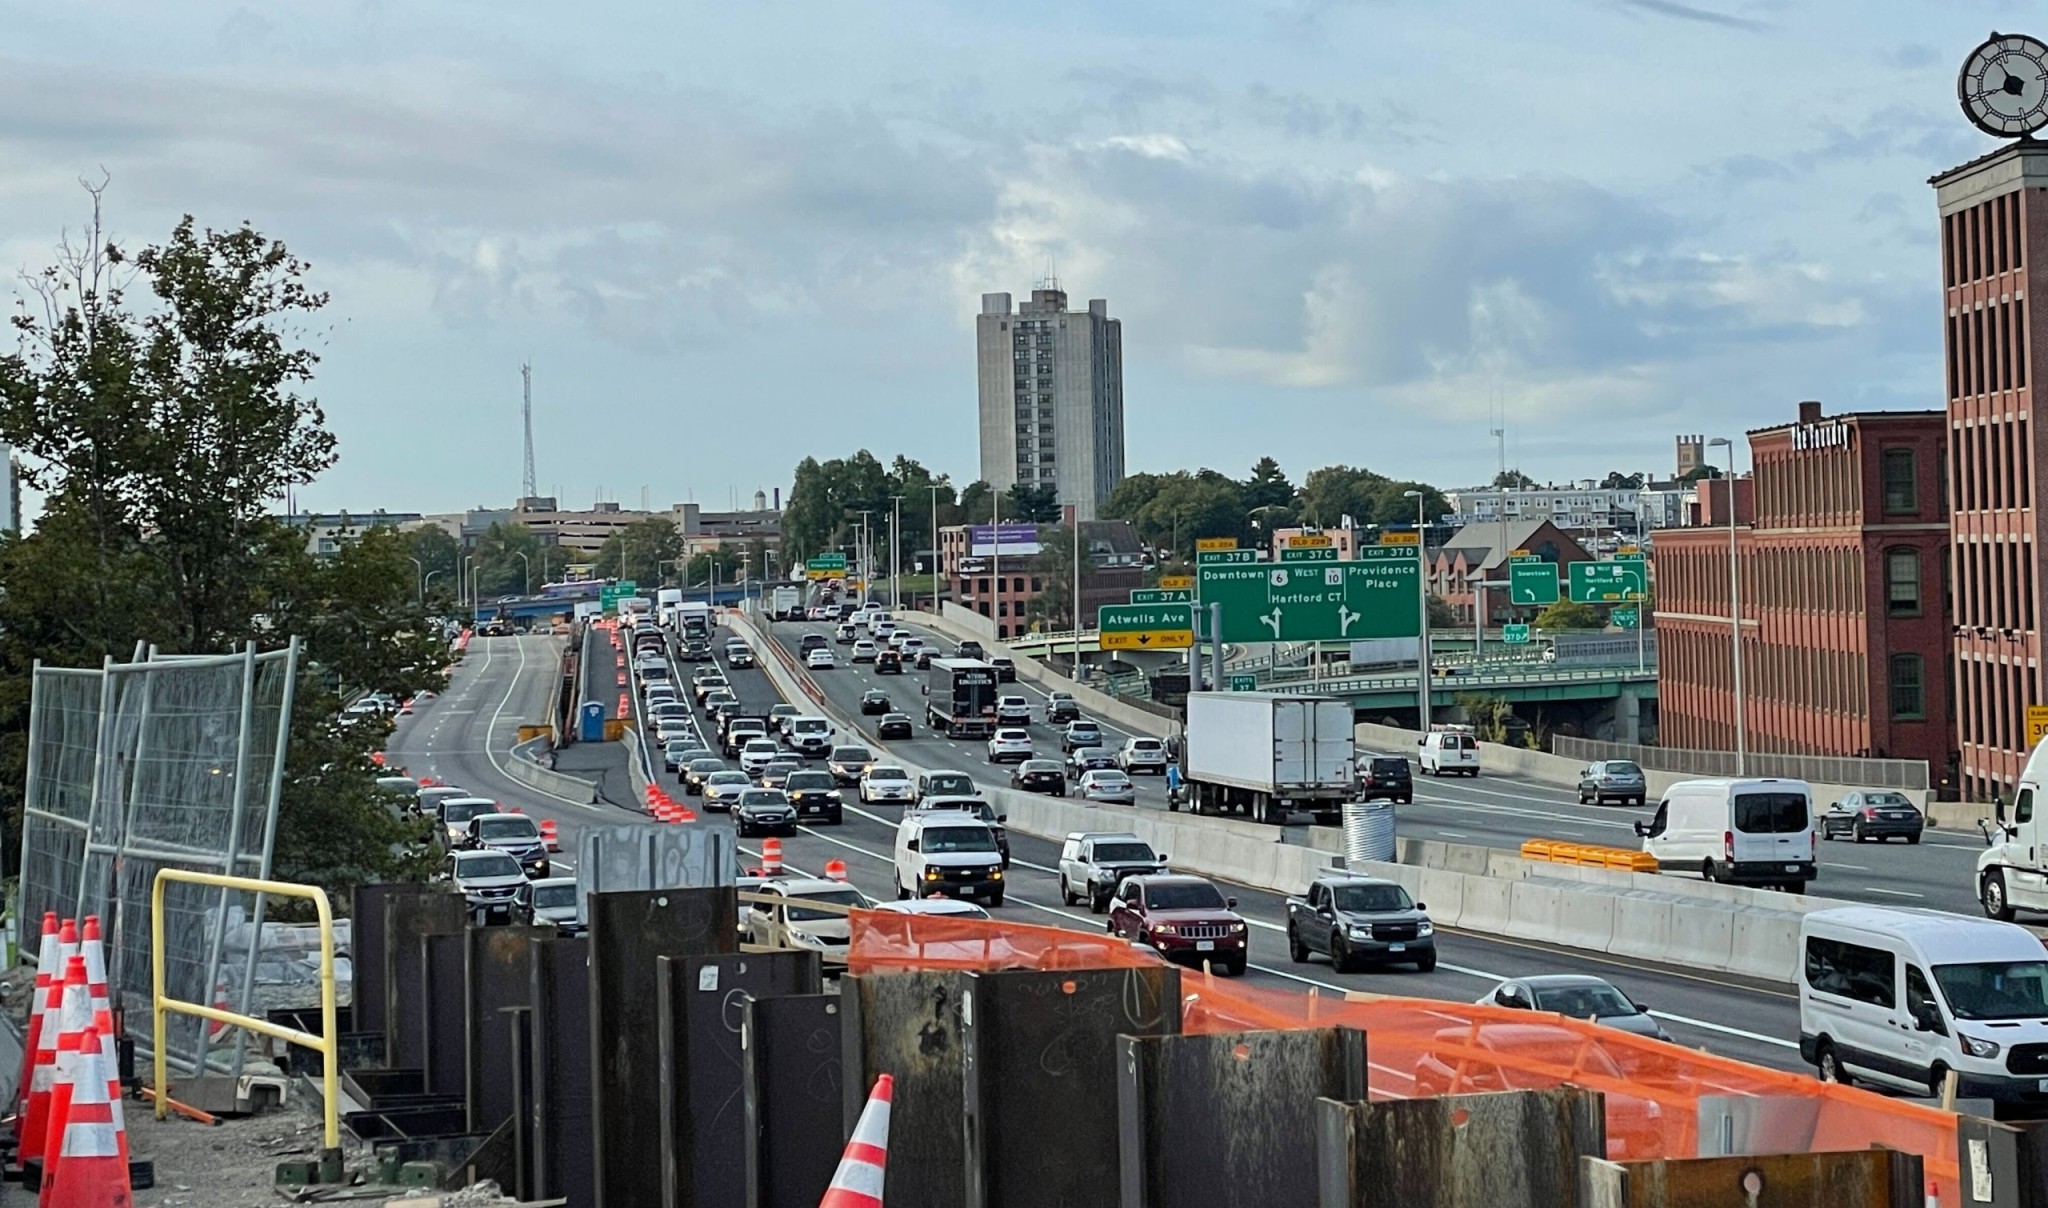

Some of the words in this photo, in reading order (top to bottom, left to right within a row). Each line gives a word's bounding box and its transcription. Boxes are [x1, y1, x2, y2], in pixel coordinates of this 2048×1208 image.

[1203, 571, 1265, 581] Downtown
[1294, 568, 1319, 577] WEST
[1348, 566, 1416, 576] Providence
[1276, 573, 1283, 584] 6
[1328, 574, 1339, 584] 10
[1366, 579, 1399, 589] Place
[1271, 593, 1323, 604] Hartford
[1327, 592, 1342, 602] CT
[1108, 613, 1156, 625] Atwells
[1161, 613, 1185, 623] Ave
[1108, 636, 1128, 645] EXIT
[1160, 635, 1185, 643] ONLY
